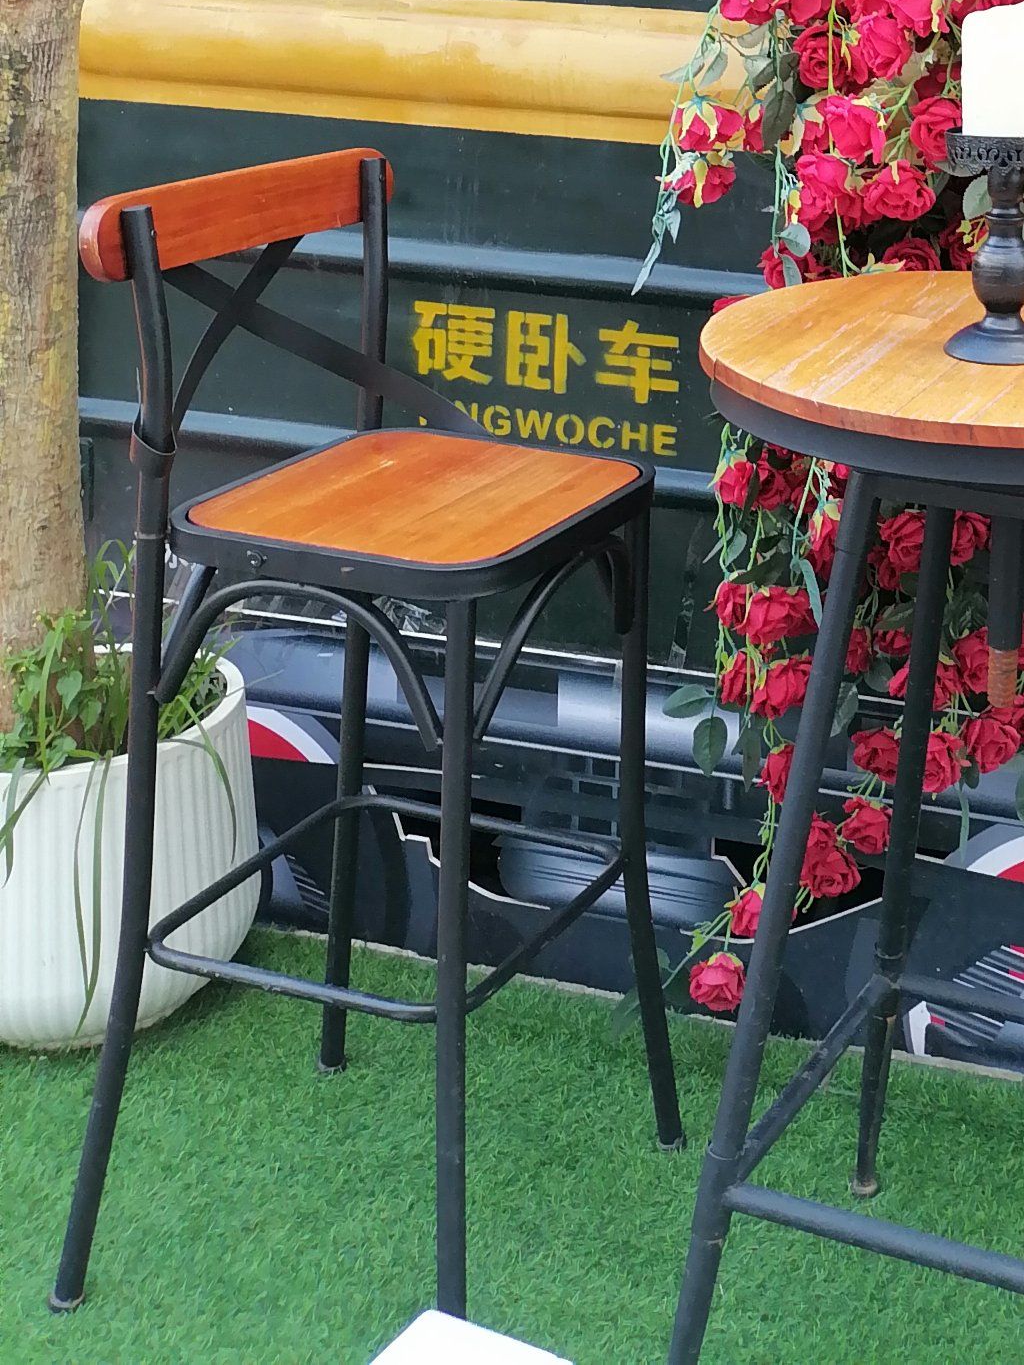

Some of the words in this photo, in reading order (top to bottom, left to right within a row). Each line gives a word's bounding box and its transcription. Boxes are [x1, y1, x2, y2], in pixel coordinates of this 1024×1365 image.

[411, 300, 680, 405] 硬卧车
[419, 399, 678, 457] NGWOCHE
